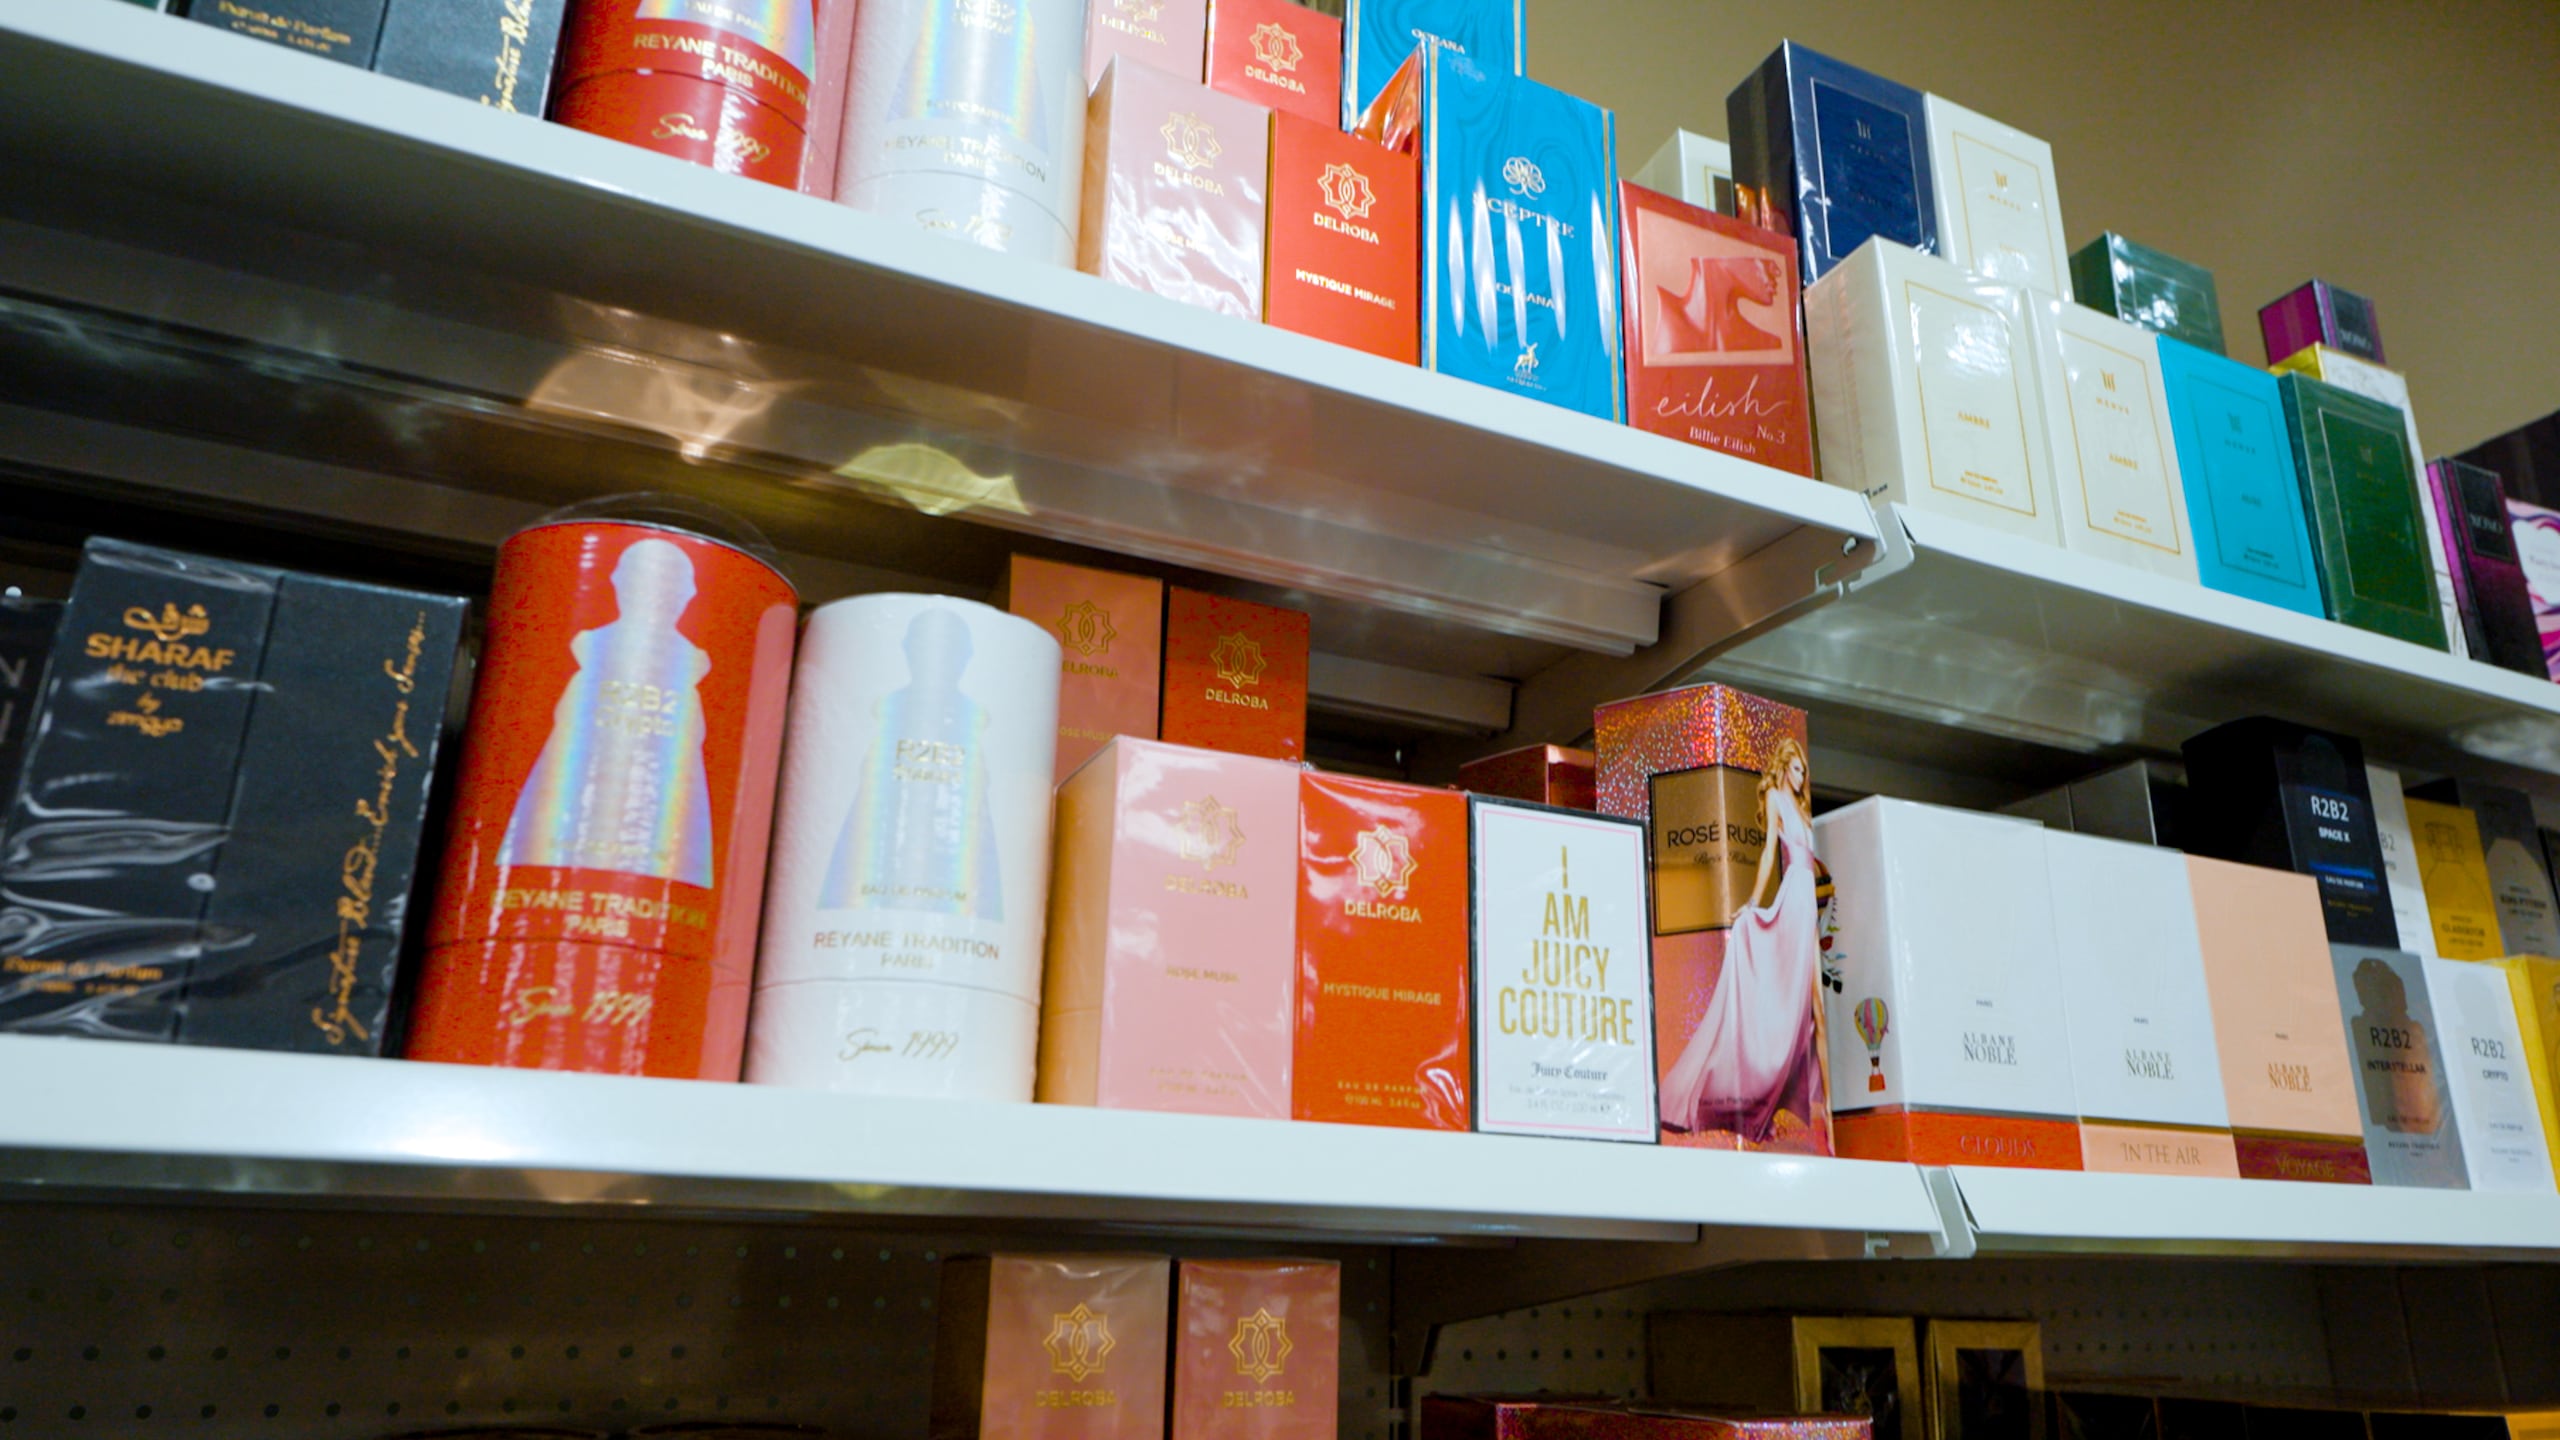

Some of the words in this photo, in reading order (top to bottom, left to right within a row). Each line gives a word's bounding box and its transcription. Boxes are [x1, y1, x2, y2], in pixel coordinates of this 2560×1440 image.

[634, 33, 717, 60] REYANE
[702, 58, 754, 89] PARIS
[1245, 64, 1306, 95] DELROBA
[1154, 160, 1225, 197] DELROBA
[1313, 211, 1379, 245] DELROBA
[1295, 267, 1352, 297] MYSTIQUE
[1353, 286, 1396, 310] MIRAGE
[1651, 371, 1791, 419] eilish
[1688, 425, 1721, 446] Billie
[1722, 434, 1757, 456] Eilish
[84, 631, 236, 672] SHARAF
[150, 667, 205, 693] club
[1062, 660, 1118, 680] ELROBA
[1205, 687, 1269, 710] DELROBA
[2310, 795, 2350, 822] R2B2
[1666, 820, 1720, 848] ROSÉ
[1561, 845, 1569, 889] I
[1163, 872, 1249, 899] DELROBA
[490, 887, 584, 912] REYANE
[590, 891, 708, 929] TRADITION
[1344, 898, 1422, 924] DELROBA
[1543, 891, 1590, 941] AM
[813, 931, 892, 949] REYANE
[902, 932, 1001, 961] TRADITION
[1522, 939, 1610, 993] JUICY
[1323, 982, 1390, 1000] MYSTIQUE
[1392, 988, 1441, 1006] MIRAGE
[582, 990, 654, 1028] 1999
[1499, 986, 1635, 1046] COUTURE
[902, 1030, 960, 1060] 1999
[1963, 1032, 2015, 1048] ALBANE
[2370, 1026, 2412, 1049] R2B2
[2471, 1036, 2506, 1060] R2B2
[1964, 1044, 2017, 1065] NOBLE
[2125, 1049, 2171, 1064] ALBANE
[2268, 1061, 2309, 1074] ALBANE
[2367, 1059, 2426, 1074] INTERSTELLAR
[1530, 1061, 1562, 1079] Juicy
[1563, 1064, 1609, 1081] Couture
[2126, 1059, 2174, 1080] NOBLE
[2268, 1072, 2312, 1092] NOBLE
[1959, 1134, 2036, 1158] CLOUDS
[2120, 1142, 2141, 1162] IN
[2144, 1143, 2170, 1164] THE
[2173, 1146, 2201, 1166] AIR
[2275, 1152, 2335, 1178] VOYAGE
[1035, 1390, 1117, 1407] DELROBA
[1223, 1390, 1295, 1407] DELROBA
